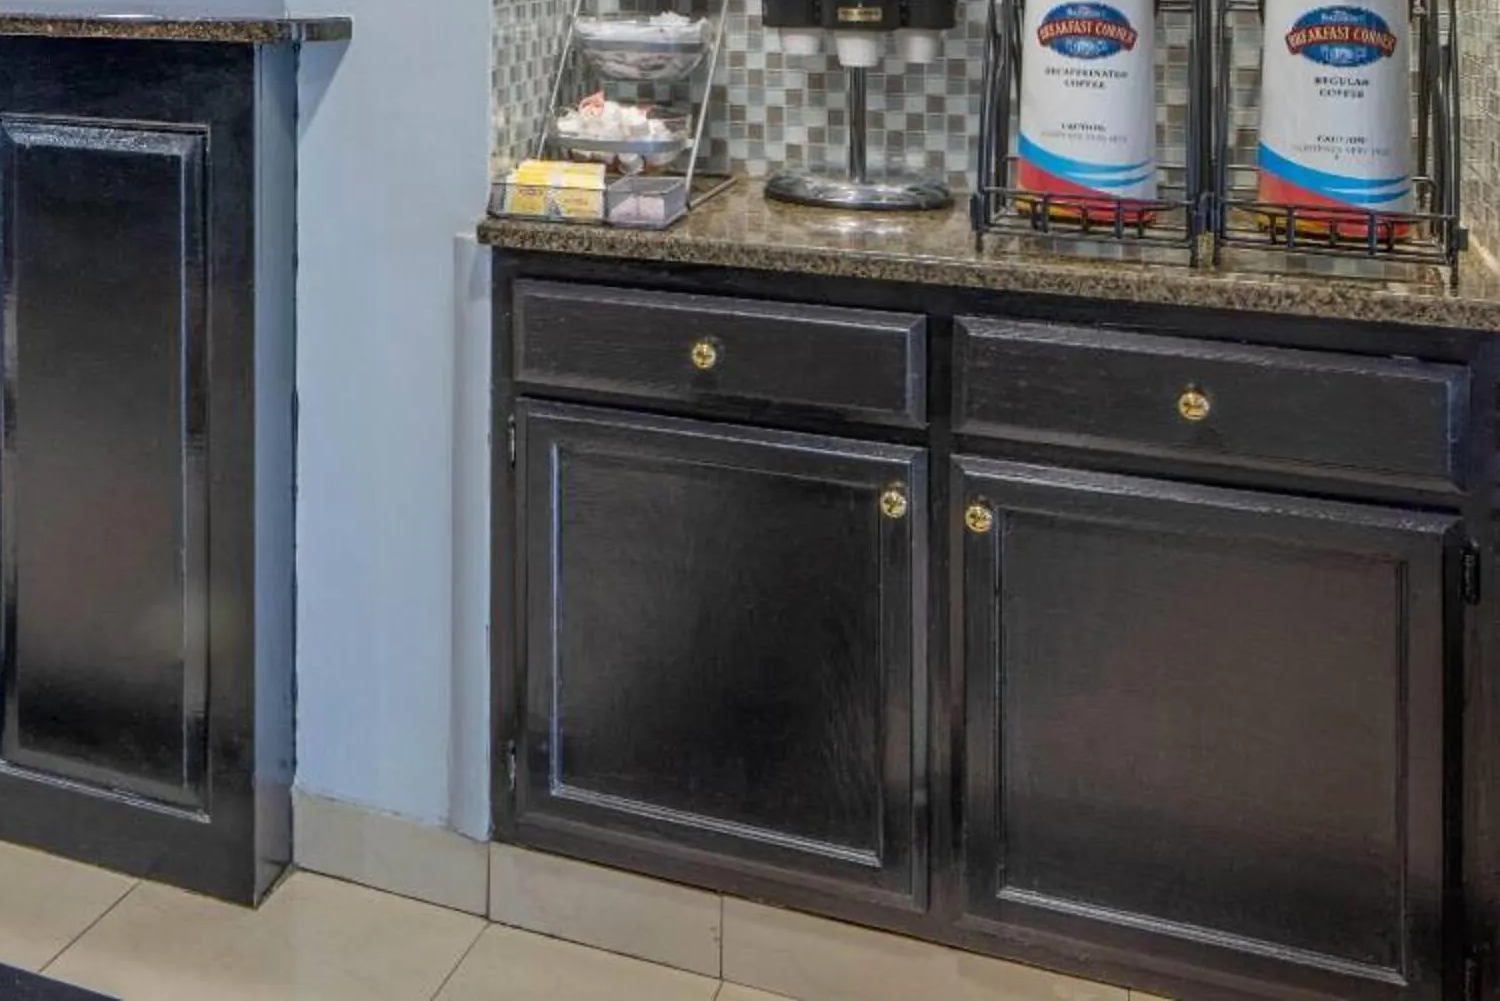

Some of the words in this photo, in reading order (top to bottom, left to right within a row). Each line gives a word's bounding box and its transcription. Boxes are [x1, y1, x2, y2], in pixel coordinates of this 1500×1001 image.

[1040, 20, 1093, 42] BREAKFAST
[1095, 22, 1136, 45] CORNER
[1288, 26, 1350, 49] BREAKFAST
[1352, 29, 1395, 52] CORNER
